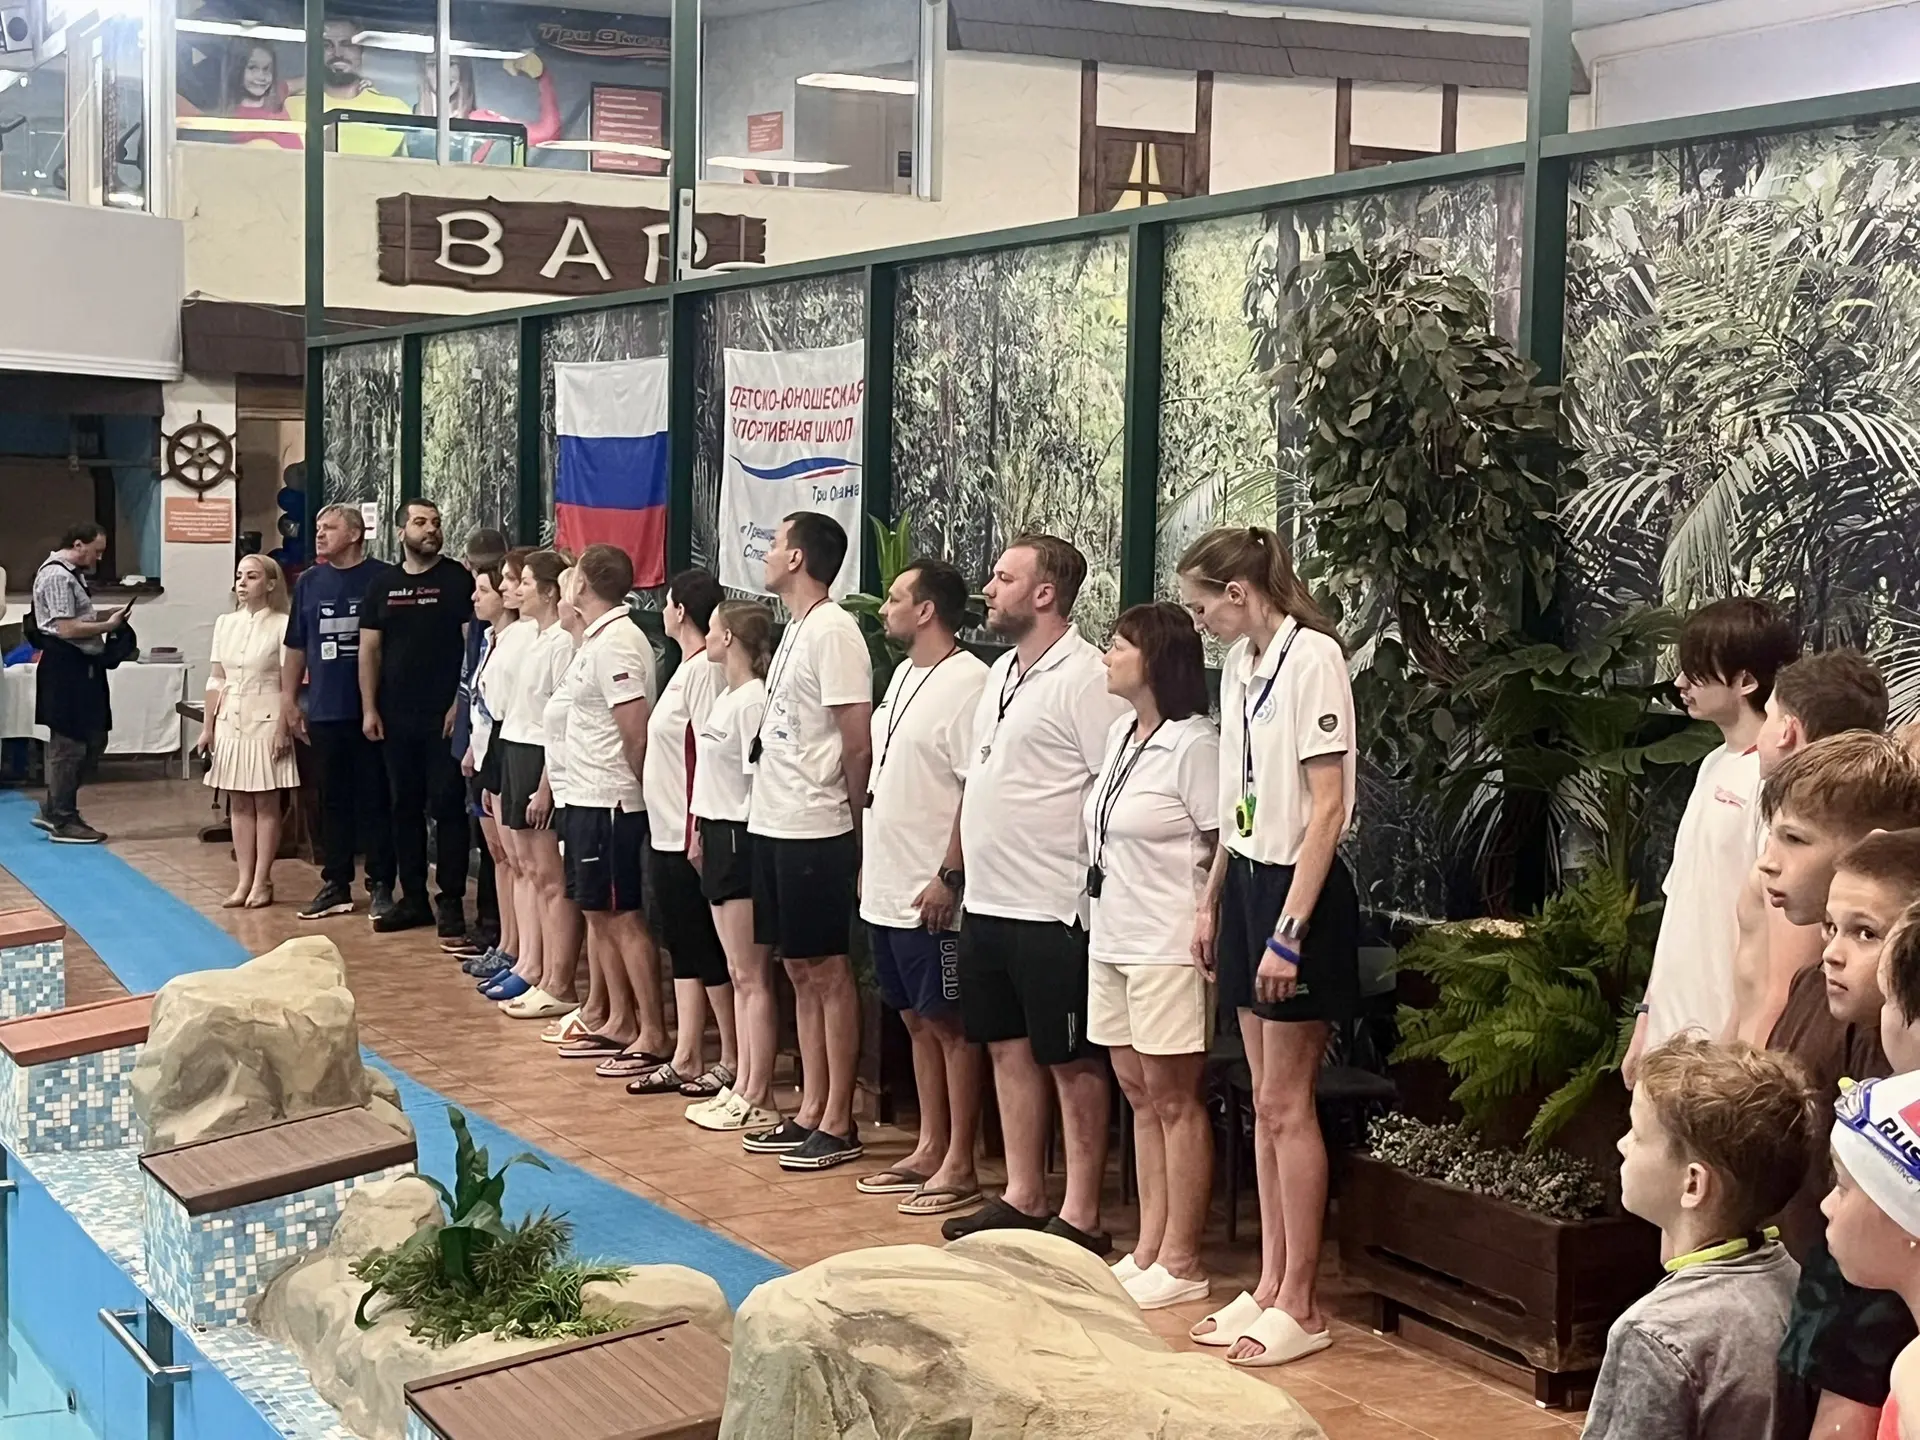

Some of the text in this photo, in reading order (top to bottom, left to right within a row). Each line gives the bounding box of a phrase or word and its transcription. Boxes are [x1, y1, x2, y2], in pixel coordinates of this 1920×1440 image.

[730, 379, 864, 411] ДЕТСКО-ЮНОШЕСКАЯ
[815, 417, 854, 443] ШКОЛ
[939, 939, 960, 1000] arena
[1876, 1116, 1920, 1168] RUS
